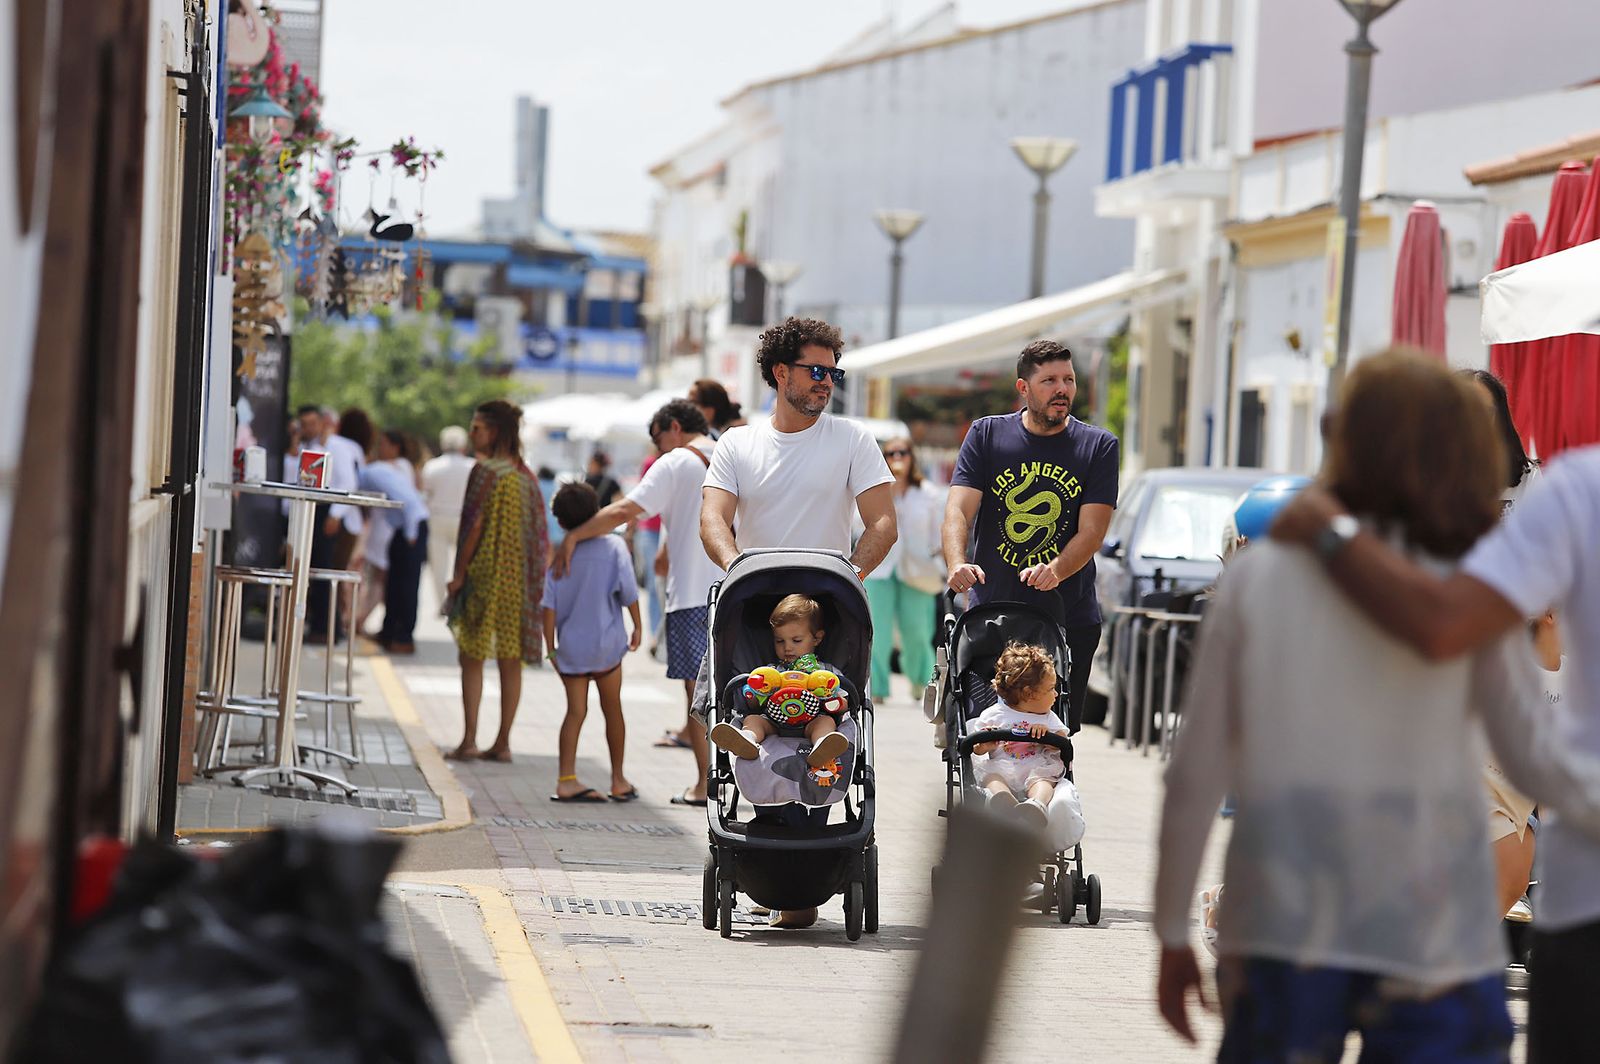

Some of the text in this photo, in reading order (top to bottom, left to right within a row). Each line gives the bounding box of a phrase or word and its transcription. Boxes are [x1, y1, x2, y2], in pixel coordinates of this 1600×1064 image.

[991, 468, 1015, 496] LOS
[1021, 461, 1082, 498] ANGELES
[996, 542, 1060, 567] ALL CITY
